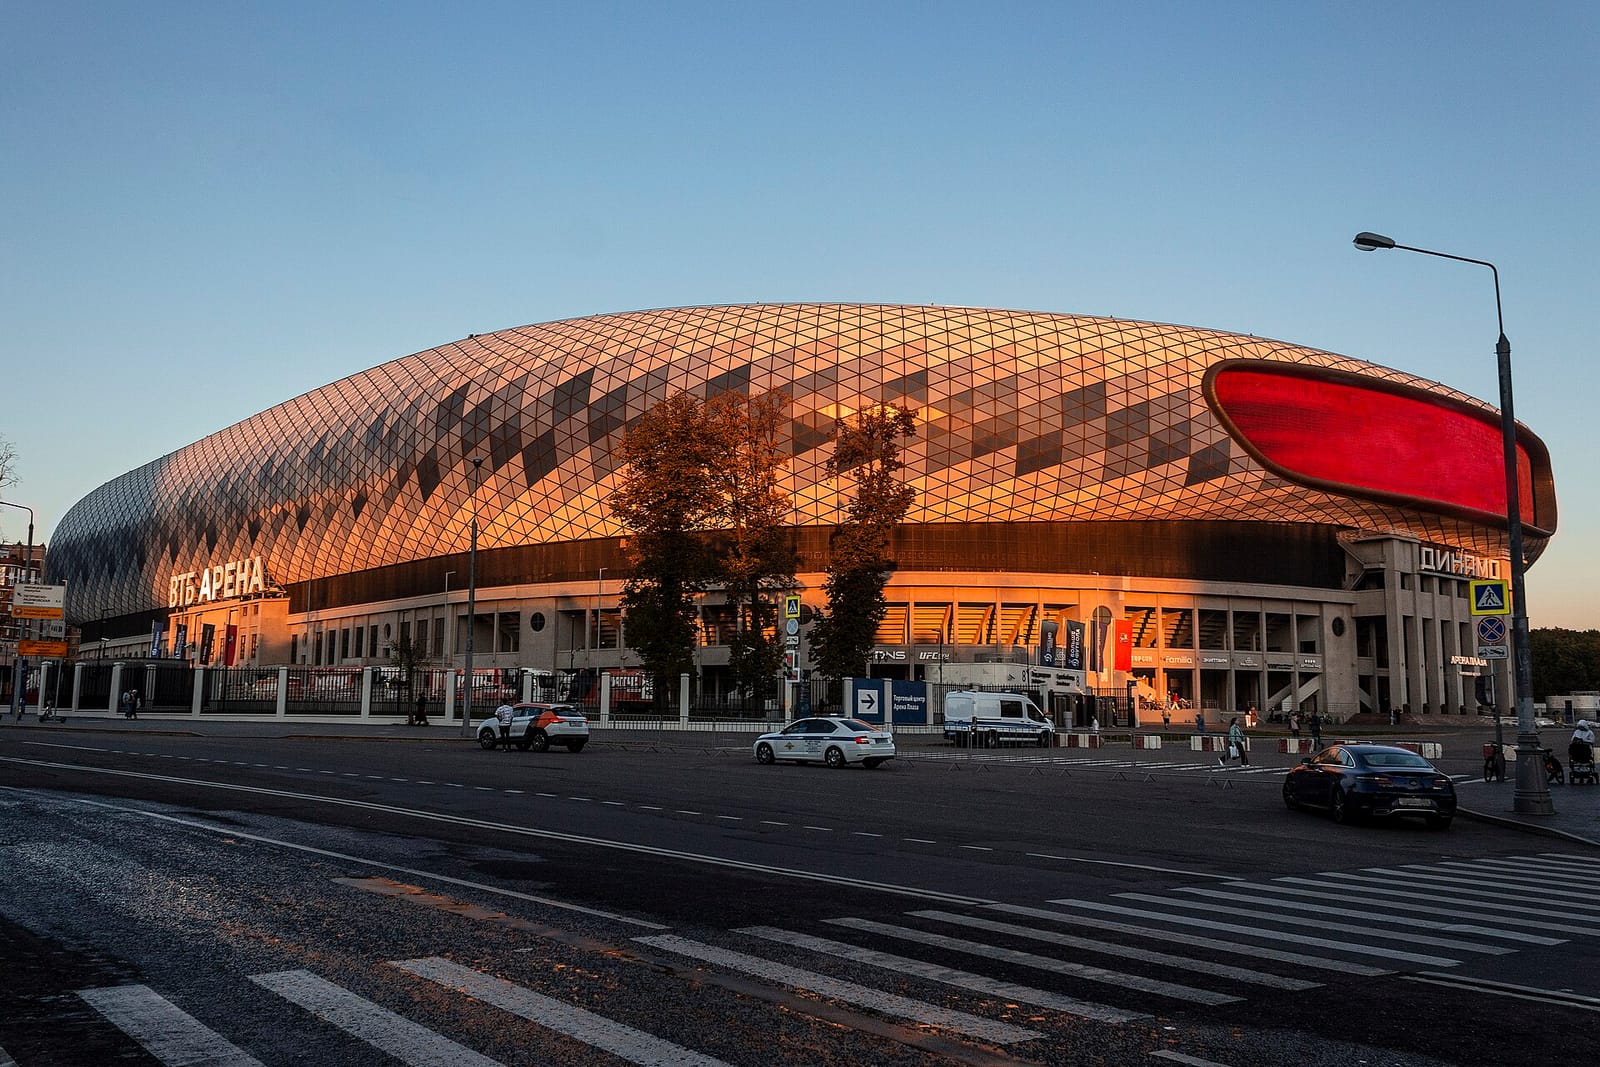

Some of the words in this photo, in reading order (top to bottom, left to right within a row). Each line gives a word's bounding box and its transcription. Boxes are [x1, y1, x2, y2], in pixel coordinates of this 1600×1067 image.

[1420, 546, 1501, 579] ДИНАМО
[169, 571, 196, 608] ВТБ
[198, 555, 264, 602] АРЕНА
[874, 650, 906, 660] DNS
[1165, 655, 1193, 664] Familia
[893, 703, 906, 711] Арена
